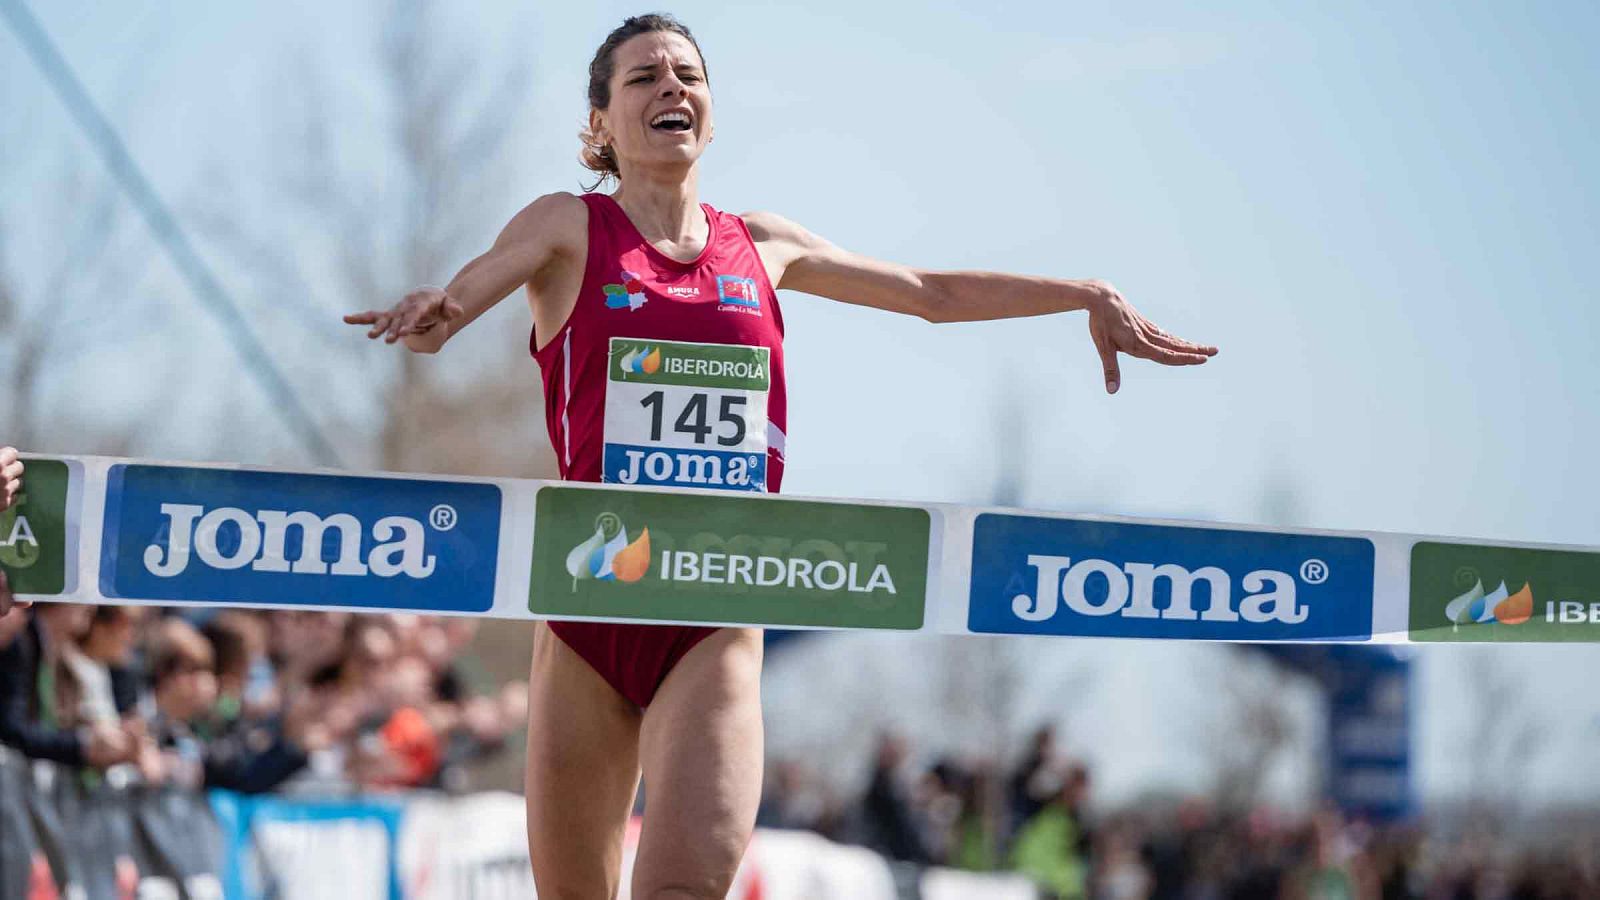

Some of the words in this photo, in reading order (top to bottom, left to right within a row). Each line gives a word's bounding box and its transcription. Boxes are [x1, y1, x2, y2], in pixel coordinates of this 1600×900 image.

[664, 357, 764, 379] IBERDROLA
[640, 391, 747, 447] 145
[660, 550, 897, 594] IBERDROLA
